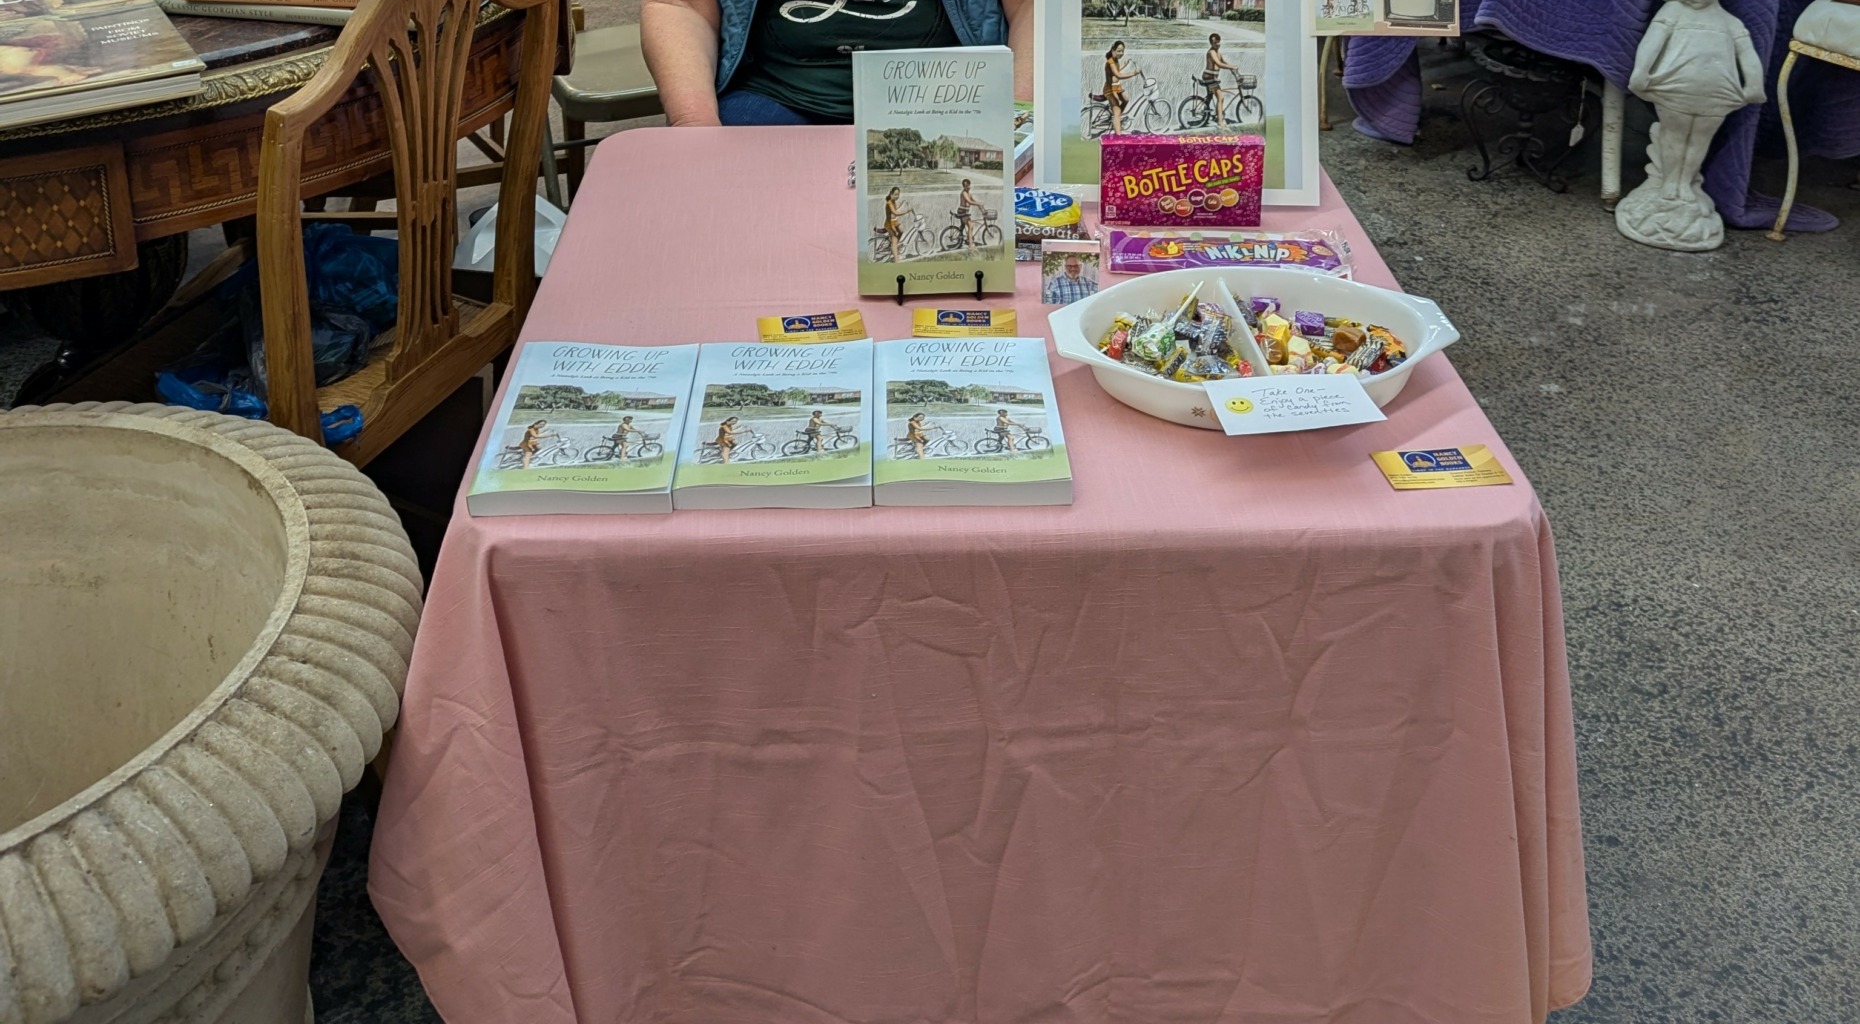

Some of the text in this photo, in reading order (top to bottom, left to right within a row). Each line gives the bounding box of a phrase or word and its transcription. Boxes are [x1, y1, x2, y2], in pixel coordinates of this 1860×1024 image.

[158, 0, 199, 12] CLASSIC
[202, 4, 246, 16] GEORGIAN
[250, 8, 274, 18] STYLE
[91, 18, 150, 32] PAINTINGS
[108, 26, 141, 34] FROM
[100, 32, 160, 45] MUSEUMS
[106, 28, 147, 39] SOVIET
[883, 60, 986, 80] GROWING UP
[888, 84, 984, 104] WITH EDDIE
[1178, 136, 1212, 144] BOTTLE
[1124, 154, 1244, 199] BOTTLE CAPS
[1035, 196, 1068, 212] Pie
[909, 271, 965, 283] Nancy Golden
[552, 346, 669, 360] GROWING UP
[731, 347, 845, 358] GROWING UP
[905, 342, 1016, 354] GROWING UP
[553, 360, 664, 374] WITH EDDIE
[734, 358, 842, 370] WITH EDDIE
[910, 355, 1016, 367] WITH EDDIE
[1252, 388, 1287, 396] Take
[1260, 397, 1294, 408] Enjoy
[1313, 394, 1345, 404] piece
[1264, 399, 1351, 413] of candy from
[1290, 408, 1350, 417] seventies
[739, 470, 773, 478] Nancy
[938, 466, 1007, 474] Nancy Golden
[537, 475, 608, 483] Nancy Golden
